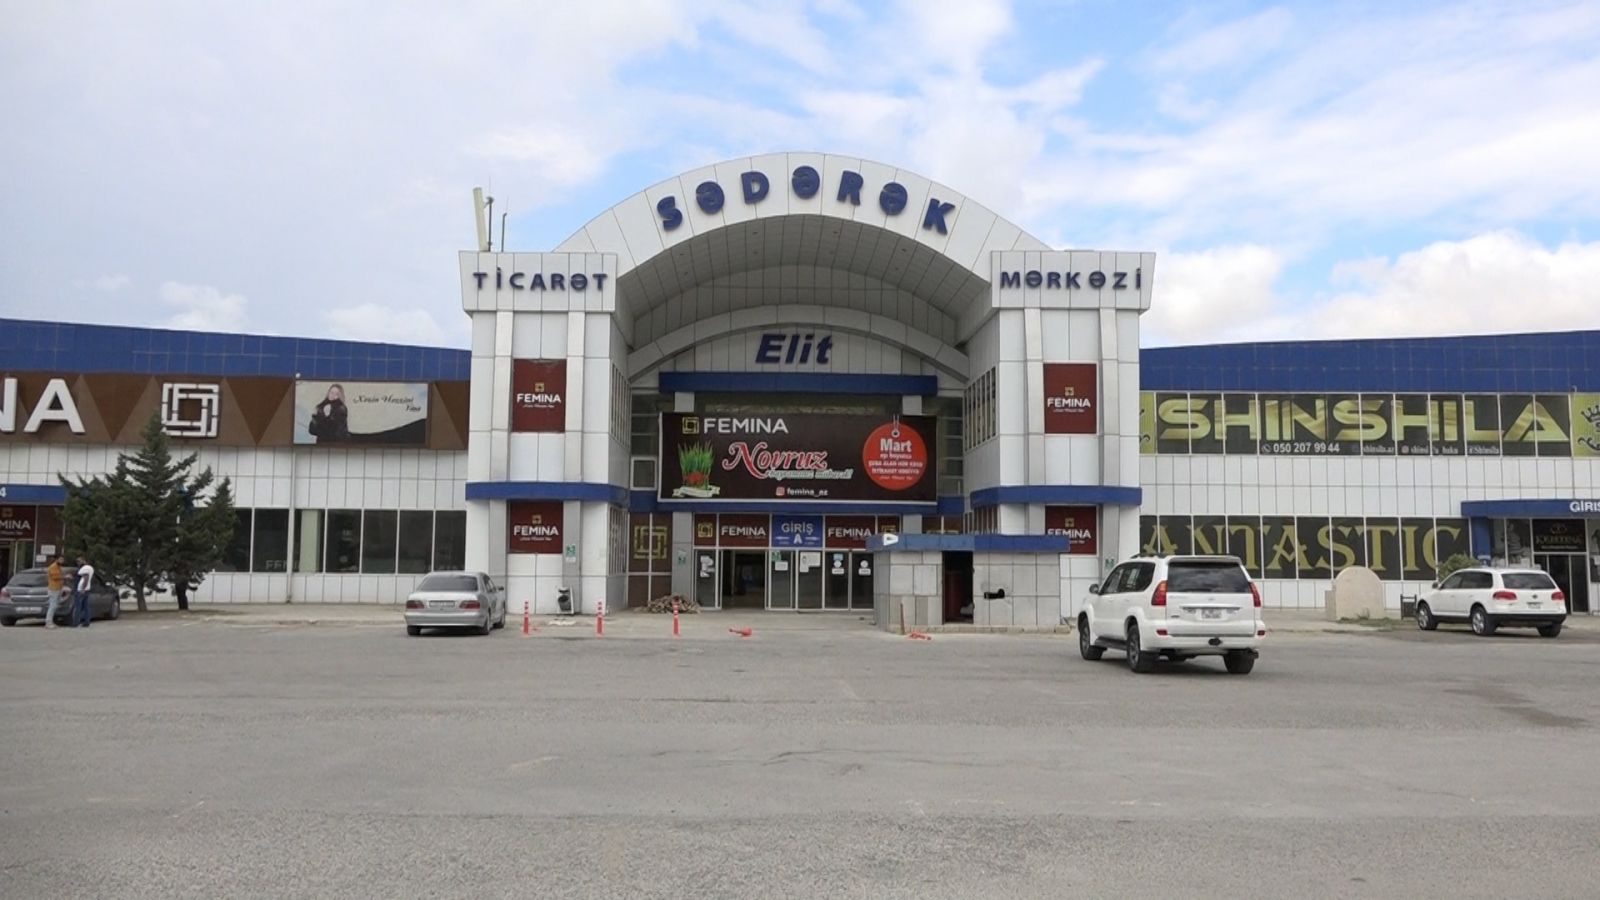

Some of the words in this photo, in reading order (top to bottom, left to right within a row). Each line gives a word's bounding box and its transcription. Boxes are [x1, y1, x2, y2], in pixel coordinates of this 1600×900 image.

[656, 166, 956, 236] SƏDƏRƏK
[473, 266, 608, 292] TİCARƏT
[1000, 266, 1142, 291] MƏRKƏZİ
[756, 328, 834, 366] Elit
[516, 393, 562, 404] FEMINA
[1046, 397, 1091, 409] FEMINA
[703, 417, 789, 434] FEMINA
[1159, 399, 1570, 441] SHINSHILA
[880, 438, 912, 452] Mart
[1273, 443, 1291, 453] 050
[1293, 443, 1311, 453] 207
[1313, 443, 1326, 453] 99
[1327, 443, 1340, 453] 44
[721, 441, 828, 479] Novruz
[0, 520, 31, 530] MINA
[513, 525, 559, 535] FEMINA
[721, 525, 767, 536] FEMINA
[781, 521, 814, 535] GİRİŞ
[793, 533, 803, 544] A
[827, 527, 872, 538] FEMINA
[1047, 528, 1092, 539] FEMINA
